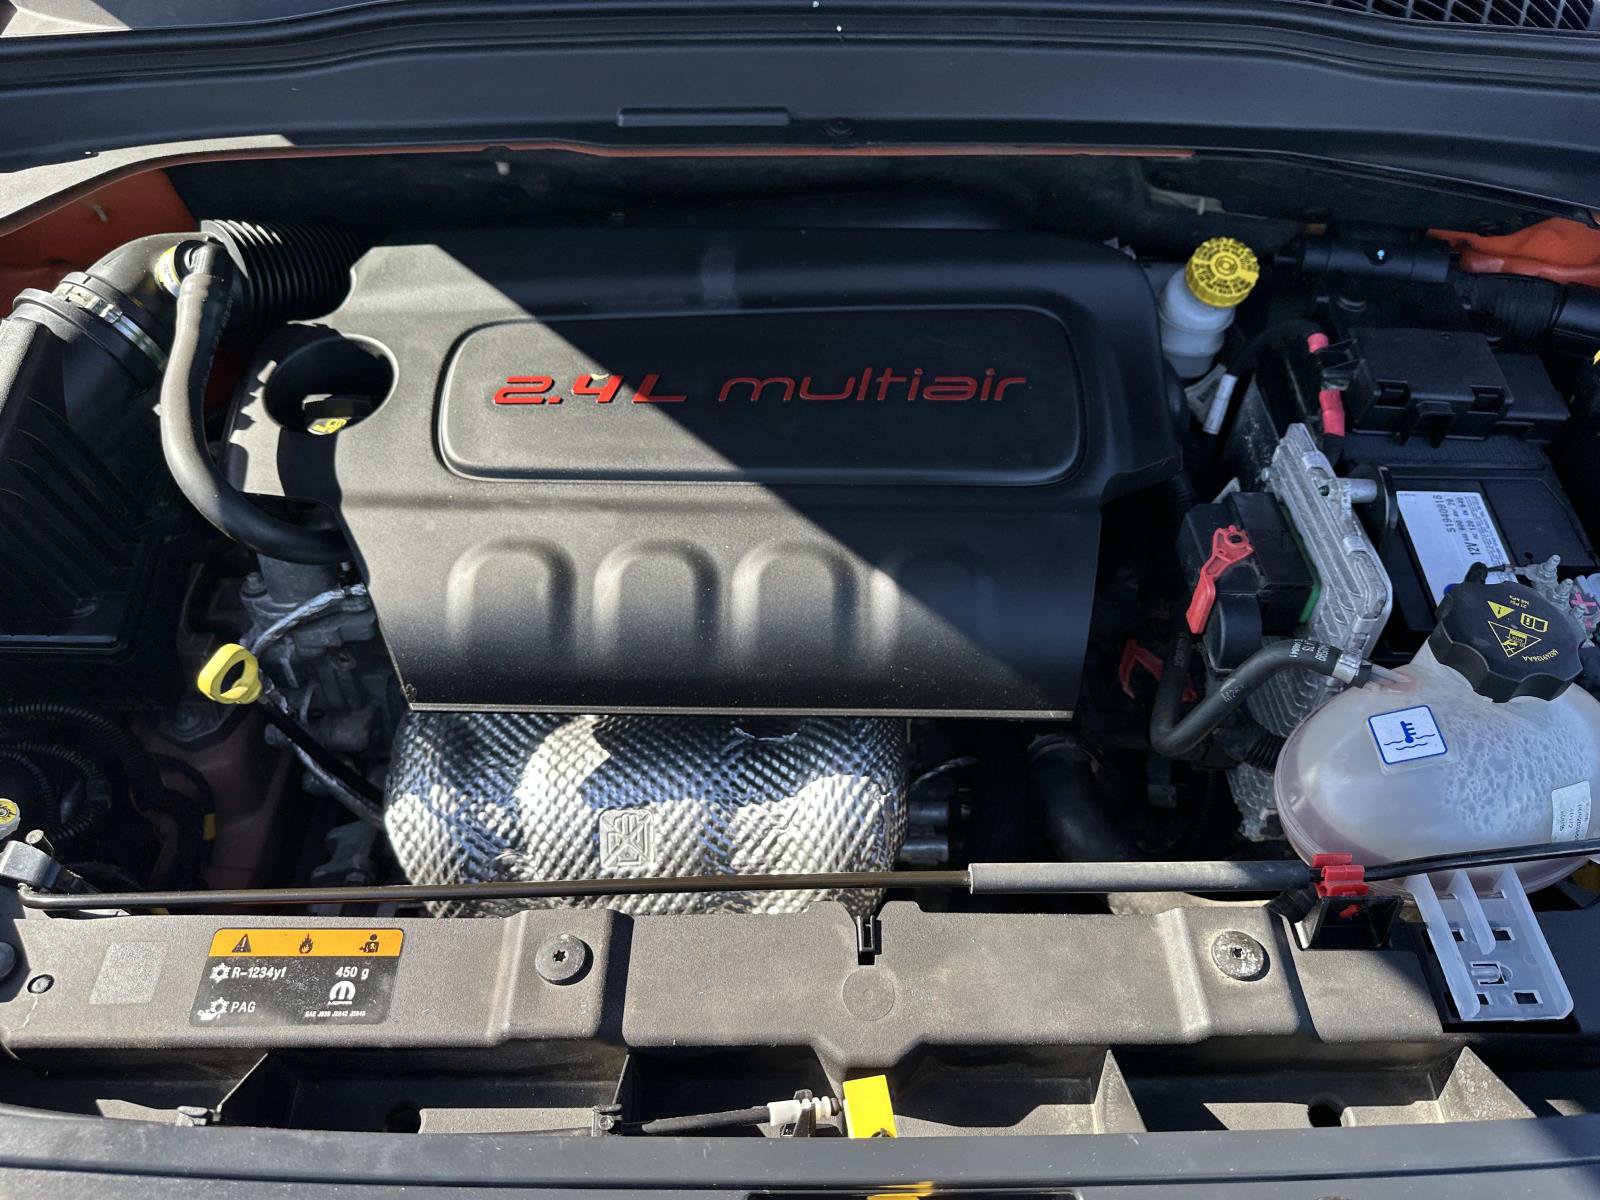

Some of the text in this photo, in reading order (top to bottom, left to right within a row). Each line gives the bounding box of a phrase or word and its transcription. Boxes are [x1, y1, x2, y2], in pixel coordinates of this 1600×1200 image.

[718, 367, 1026, 401] multiair
[1464, 542, 1481, 556] 12V
[335, 966, 358, 977] 450
[361, 967, 370, 980] g
[230, 1001, 256, 1013] PAG
